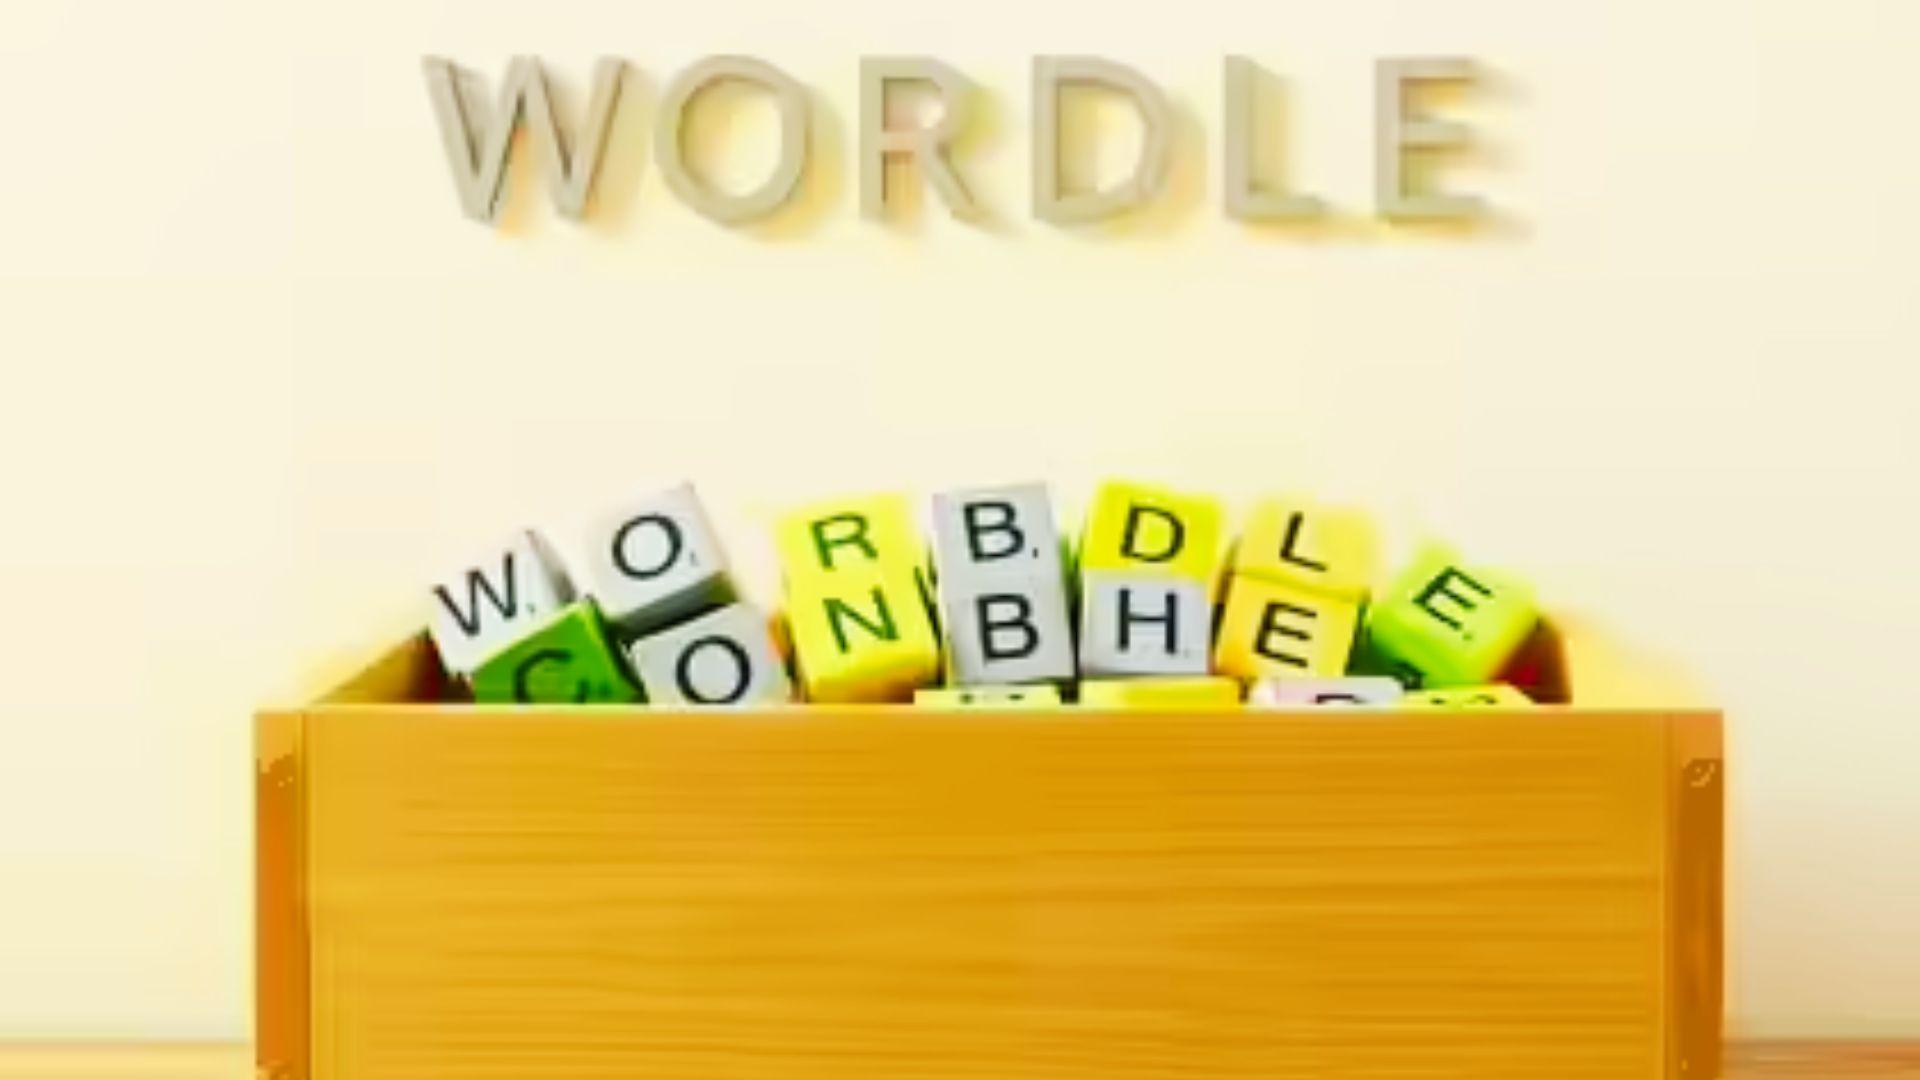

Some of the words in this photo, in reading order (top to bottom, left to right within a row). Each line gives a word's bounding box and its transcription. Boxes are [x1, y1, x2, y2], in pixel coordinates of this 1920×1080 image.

[421, 54, 1500, 228] WORDLE
[809, 512, 879, 570] R
[1119, 503, 1185, 563] D
[1278, 512, 1330, 573] L
[675, 634, 752, 704] O
[822, 586, 900, 654] N
[976, 593, 1041, 664] B
[1117, 587, 1178, 655] H
[1253, 600, 1317, 669] E
